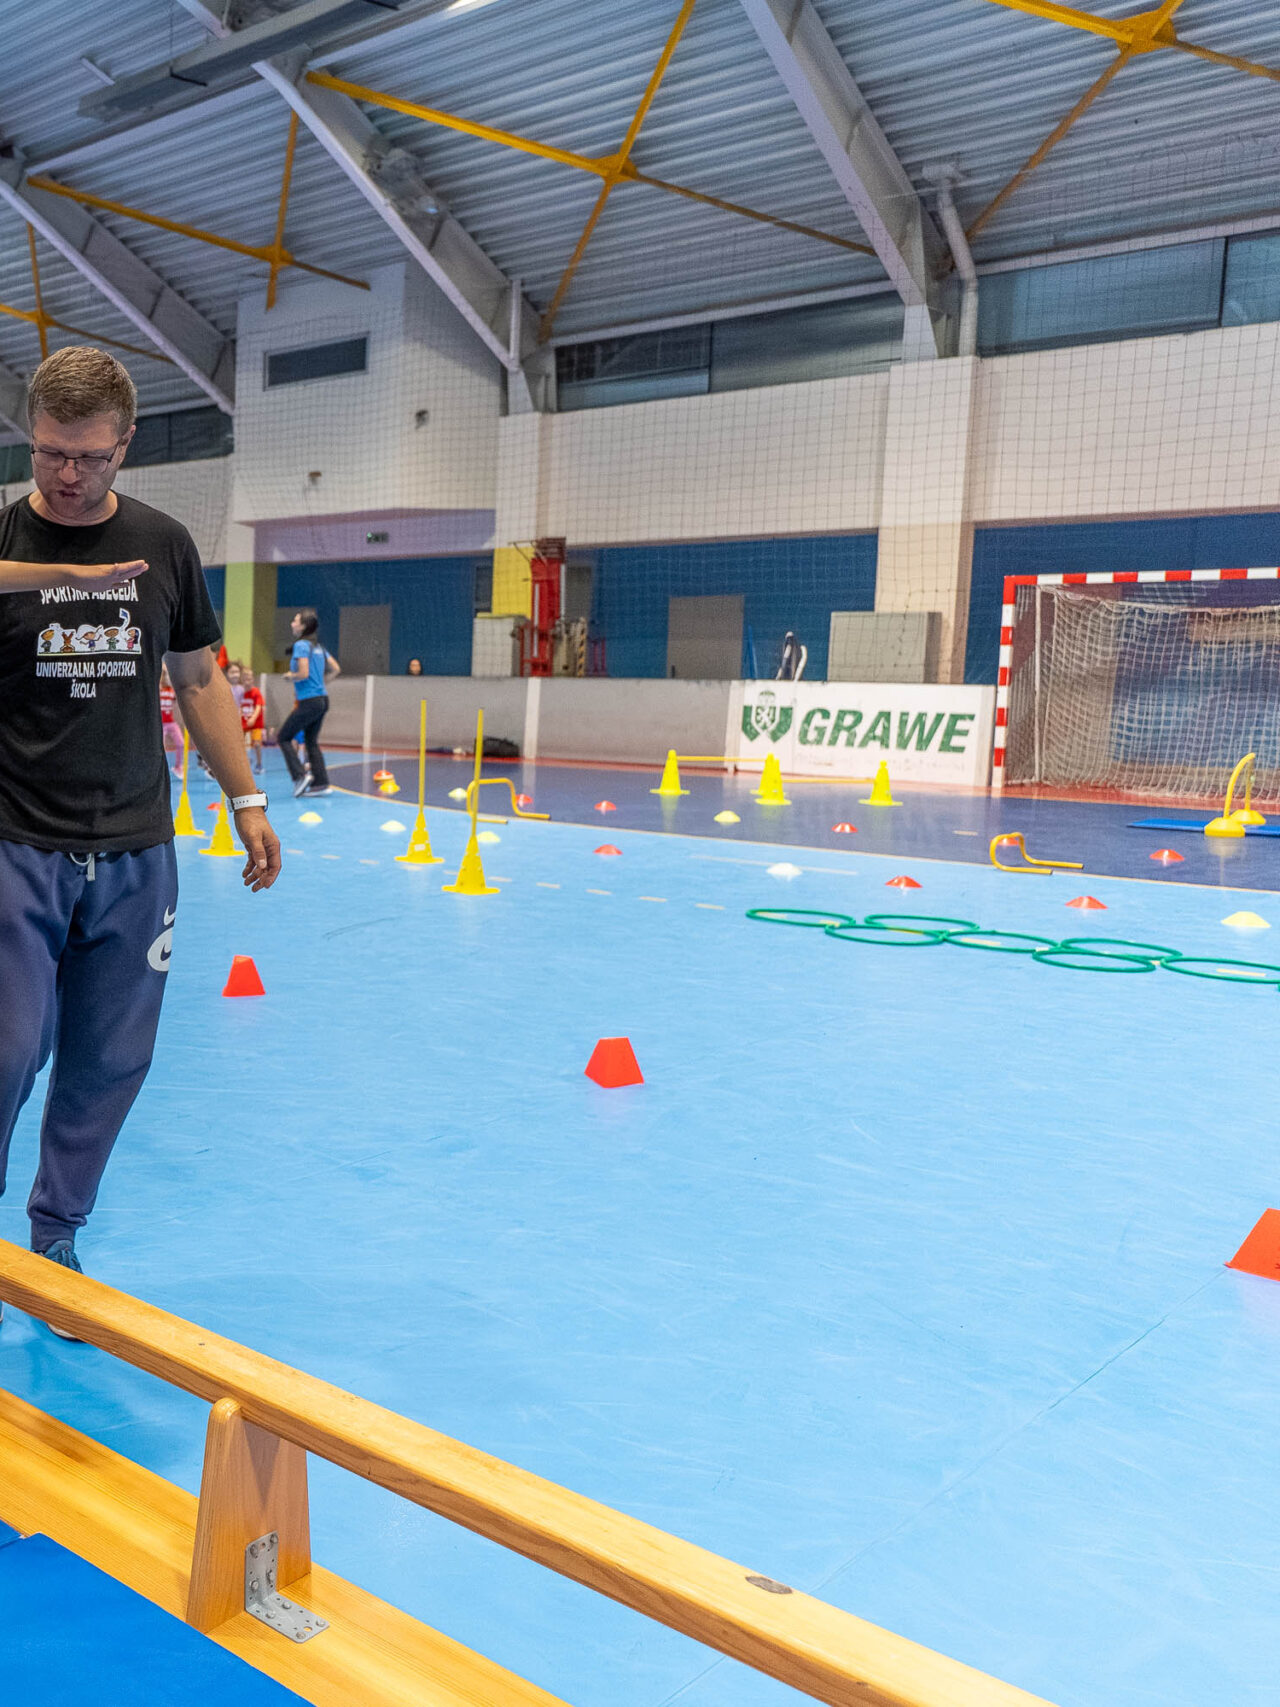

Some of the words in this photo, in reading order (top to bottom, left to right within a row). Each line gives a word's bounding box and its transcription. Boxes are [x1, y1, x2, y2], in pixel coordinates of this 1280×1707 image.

[35, 661, 96, 678] UNIVERZALNA
[96, 661, 137, 677] SPORTSKA
[70, 679, 97, 698] ŠKOLA
[797, 707, 976, 754] GRAWE
